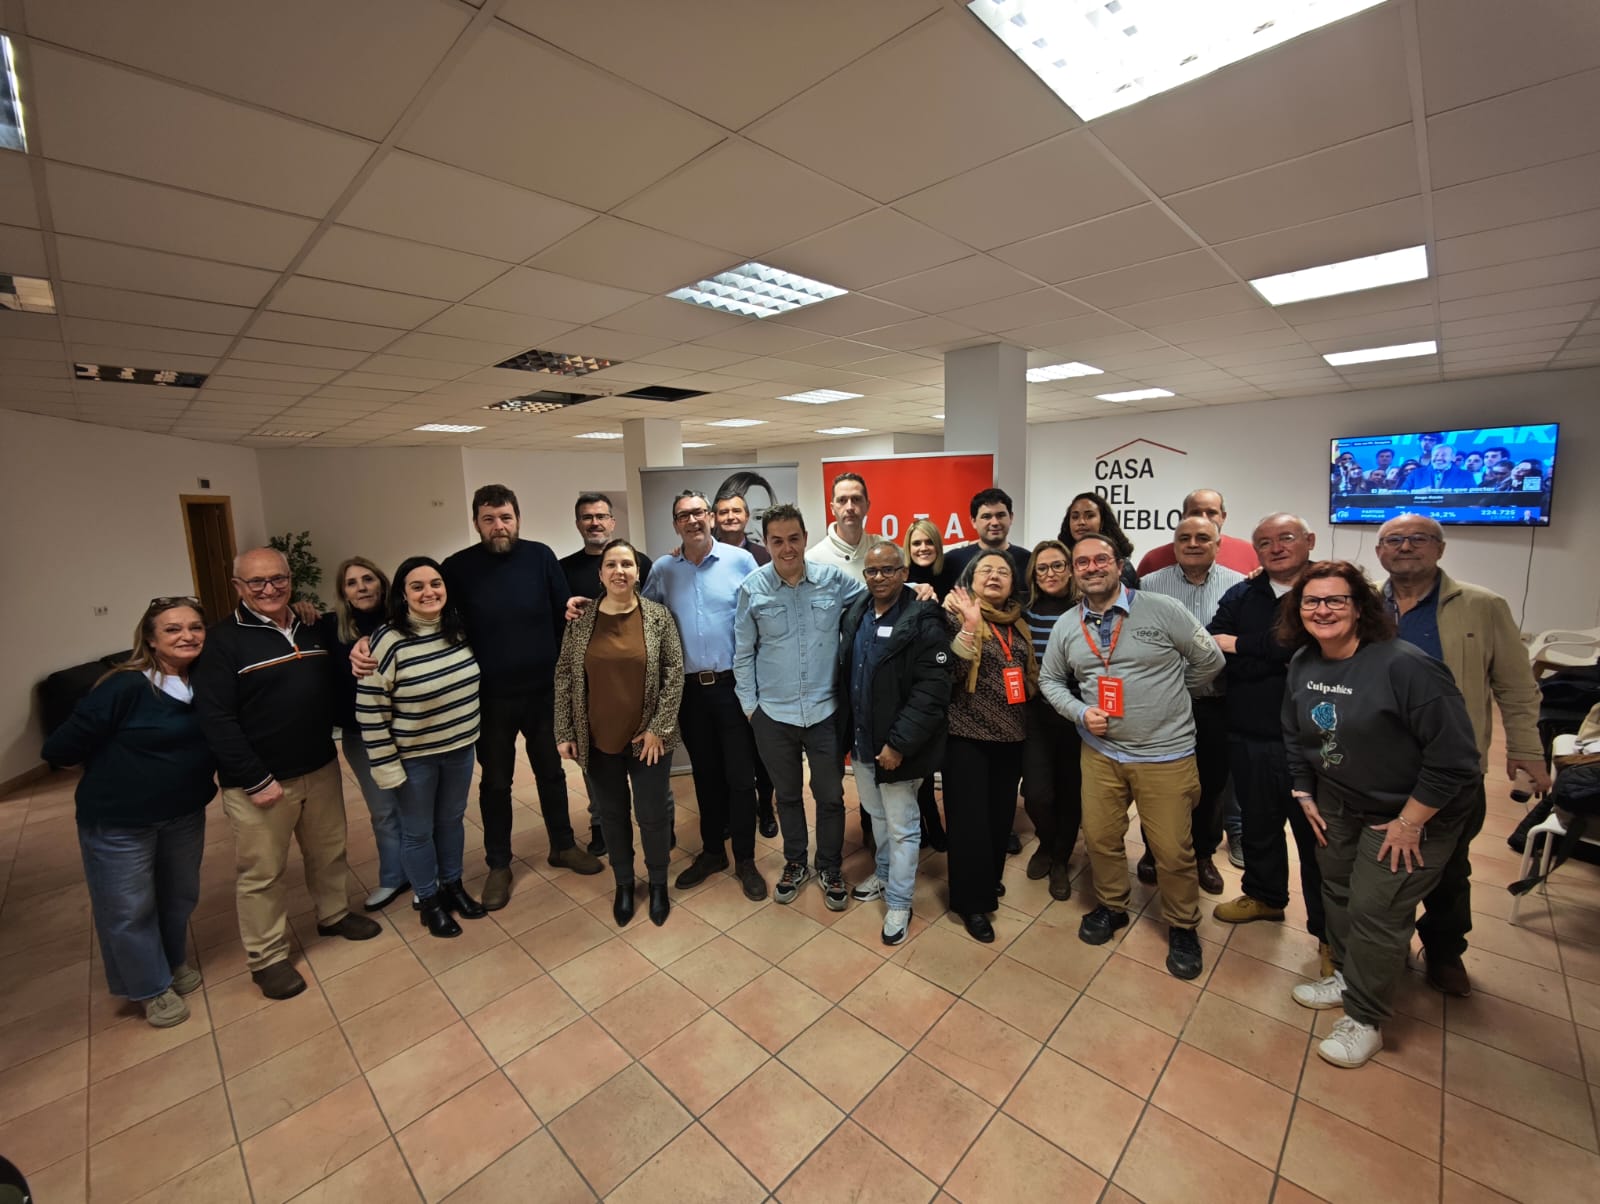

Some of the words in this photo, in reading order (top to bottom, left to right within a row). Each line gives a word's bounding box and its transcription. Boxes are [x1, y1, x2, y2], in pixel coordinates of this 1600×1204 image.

[1094, 458, 1154, 481] CASA
[1094, 484, 1135, 505] DEL
[862, 512, 965, 540] OA
[1117, 508, 1182, 531] EBLO
